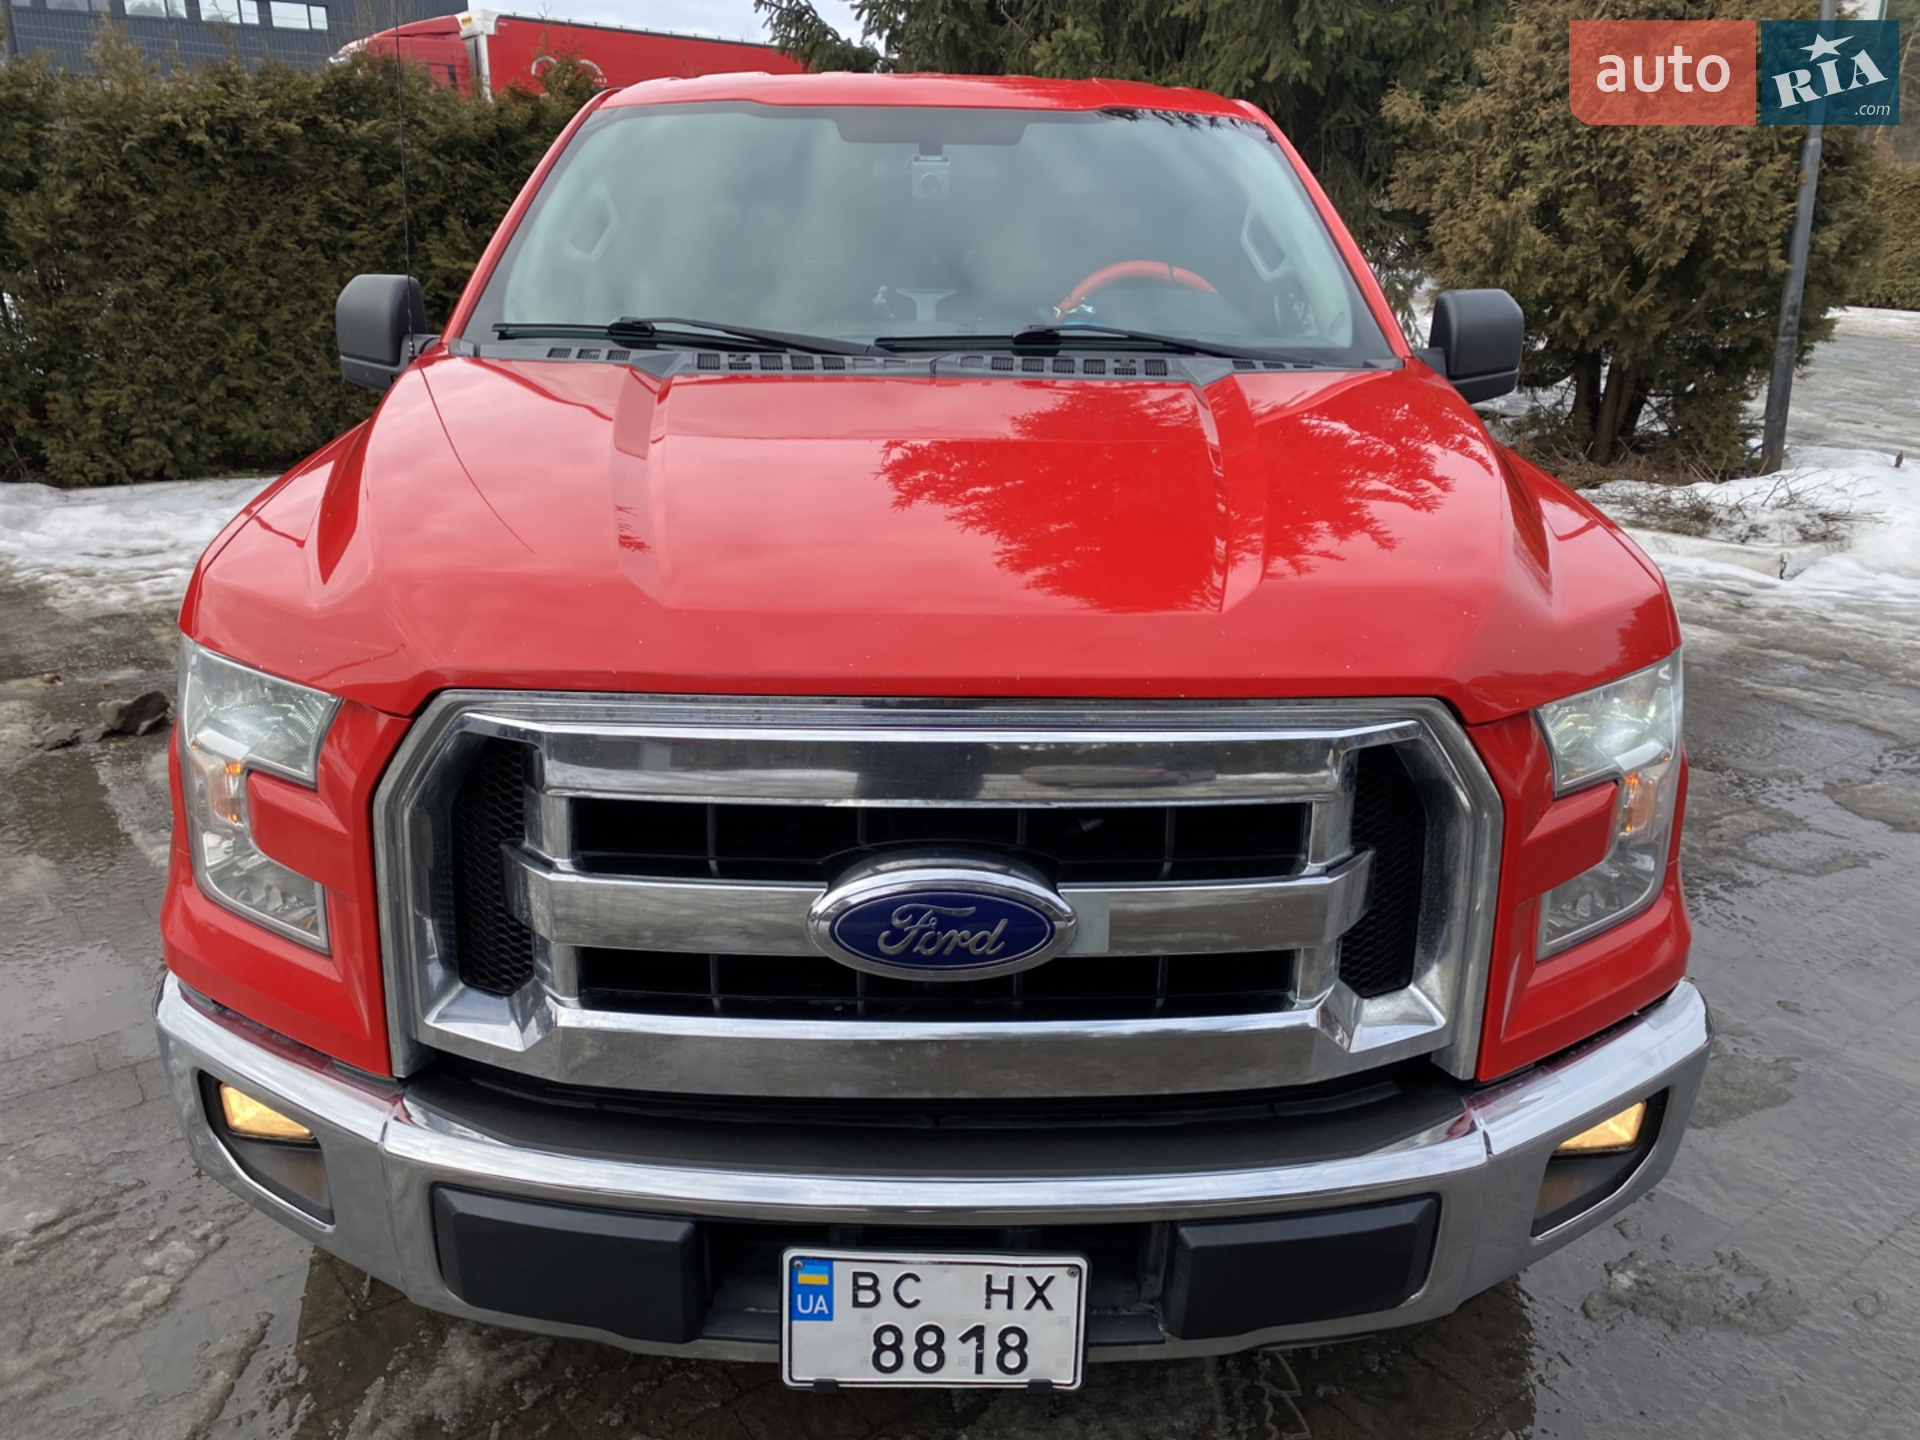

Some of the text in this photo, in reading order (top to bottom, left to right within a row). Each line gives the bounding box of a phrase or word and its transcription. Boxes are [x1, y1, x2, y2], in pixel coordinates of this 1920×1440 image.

[877, 903, 1009, 956] Ford
[796, 1294, 829, 1315] UA
[852, 1271, 1056, 1311] BC HX
[871, 1323, 1029, 1376] 8818
